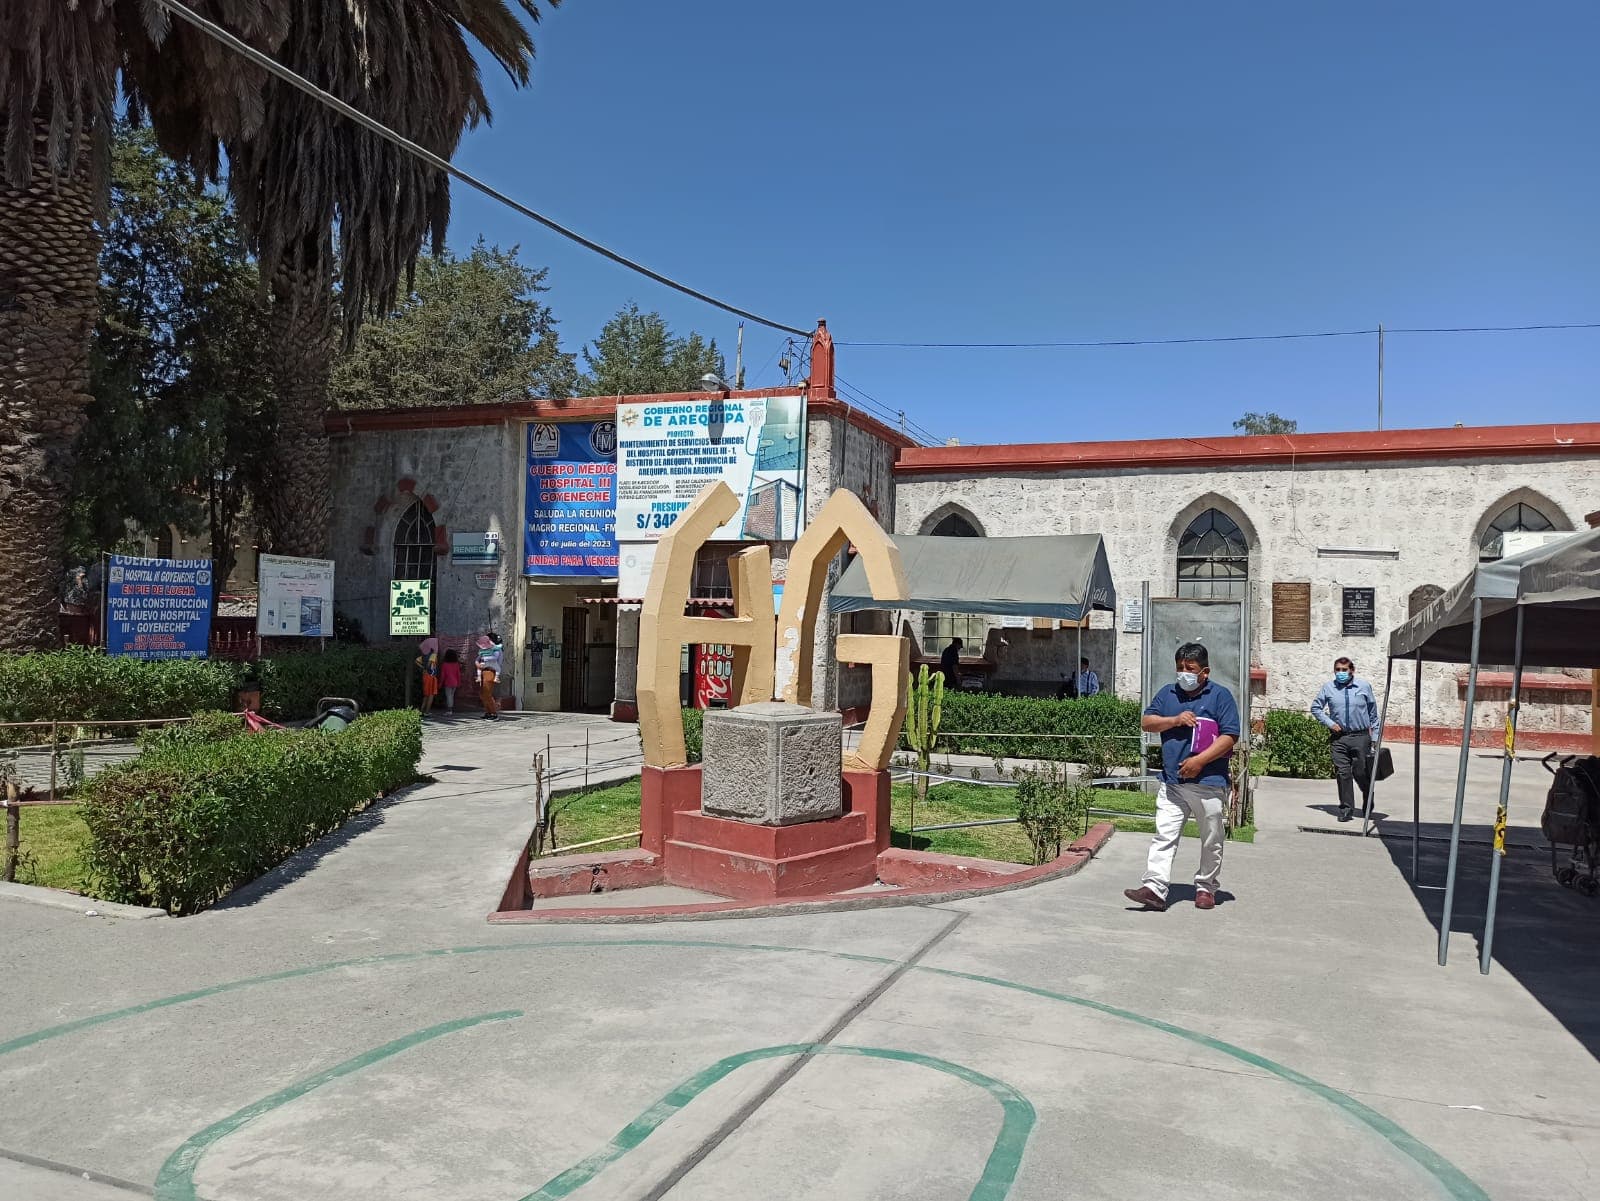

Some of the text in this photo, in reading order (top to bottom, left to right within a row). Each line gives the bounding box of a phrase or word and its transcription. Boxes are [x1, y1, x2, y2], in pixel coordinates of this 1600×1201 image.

[644, 405, 693, 415] GOBIERNO
[695, 403, 744, 413] REGIONAL
[644, 413, 744, 426] DE AREQUIPA
[619, 440, 667, 448] MANTENIMIENTO
[668, 439, 677, 447] DE
[677, 438, 710, 447] SERVICIOS
[626, 449, 637, 457] DEL
[638, 448, 666, 457] HOSPITAL
[667, 448, 700, 457] GOYENECHE
[702, 447, 719, 455] NIVEL
[625, 458, 654, 467] DISTRITO
[655, 458, 663, 466] DE
[695, 456, 728, 465] PROVINCIA
[729, 456, 737, 464] DE
[530, 462, 617, 476] CUERPO MÉDIC
[670, 466, 692, 475] REGIÓN
[693, 465, 723, 475] AREQUIPA
[540, 477, 611, 489] HOSPITAL III
[540, 490, 611, 503] GOYENECHE
[652, 501, 690, 512] PRESUPU
[534, 509, 565, 519] SALUDA
[567, 509, 577, 518] LA
[636, 513, 651, 528] S/
[529, 523, 557, 532] MACRO
[558, 523, 600, 532] REGIONAL
[453, 545, 486, 553] RENIEC
[540, 540, 549, 548] 07
[560, 540, 577, 549] julio
[579, 540, 590, 548] del
[592, 540, 611, 548] 2023
[561, 554, 584, 567] PARA
[125, 569, 153, 582] HOSPITAL
[160, 571, 195, 583] GOYENECHE
[122, 584, 196, 596] EN PIE DE LUCHA
[131, 598, 140, 608] LA
[142, 597, 208, 609] CONSTRUCCIÓN
[113, 610, 201, 621] DEL NUEVO HOSPITAL
[121, 622, 130, 633] III
